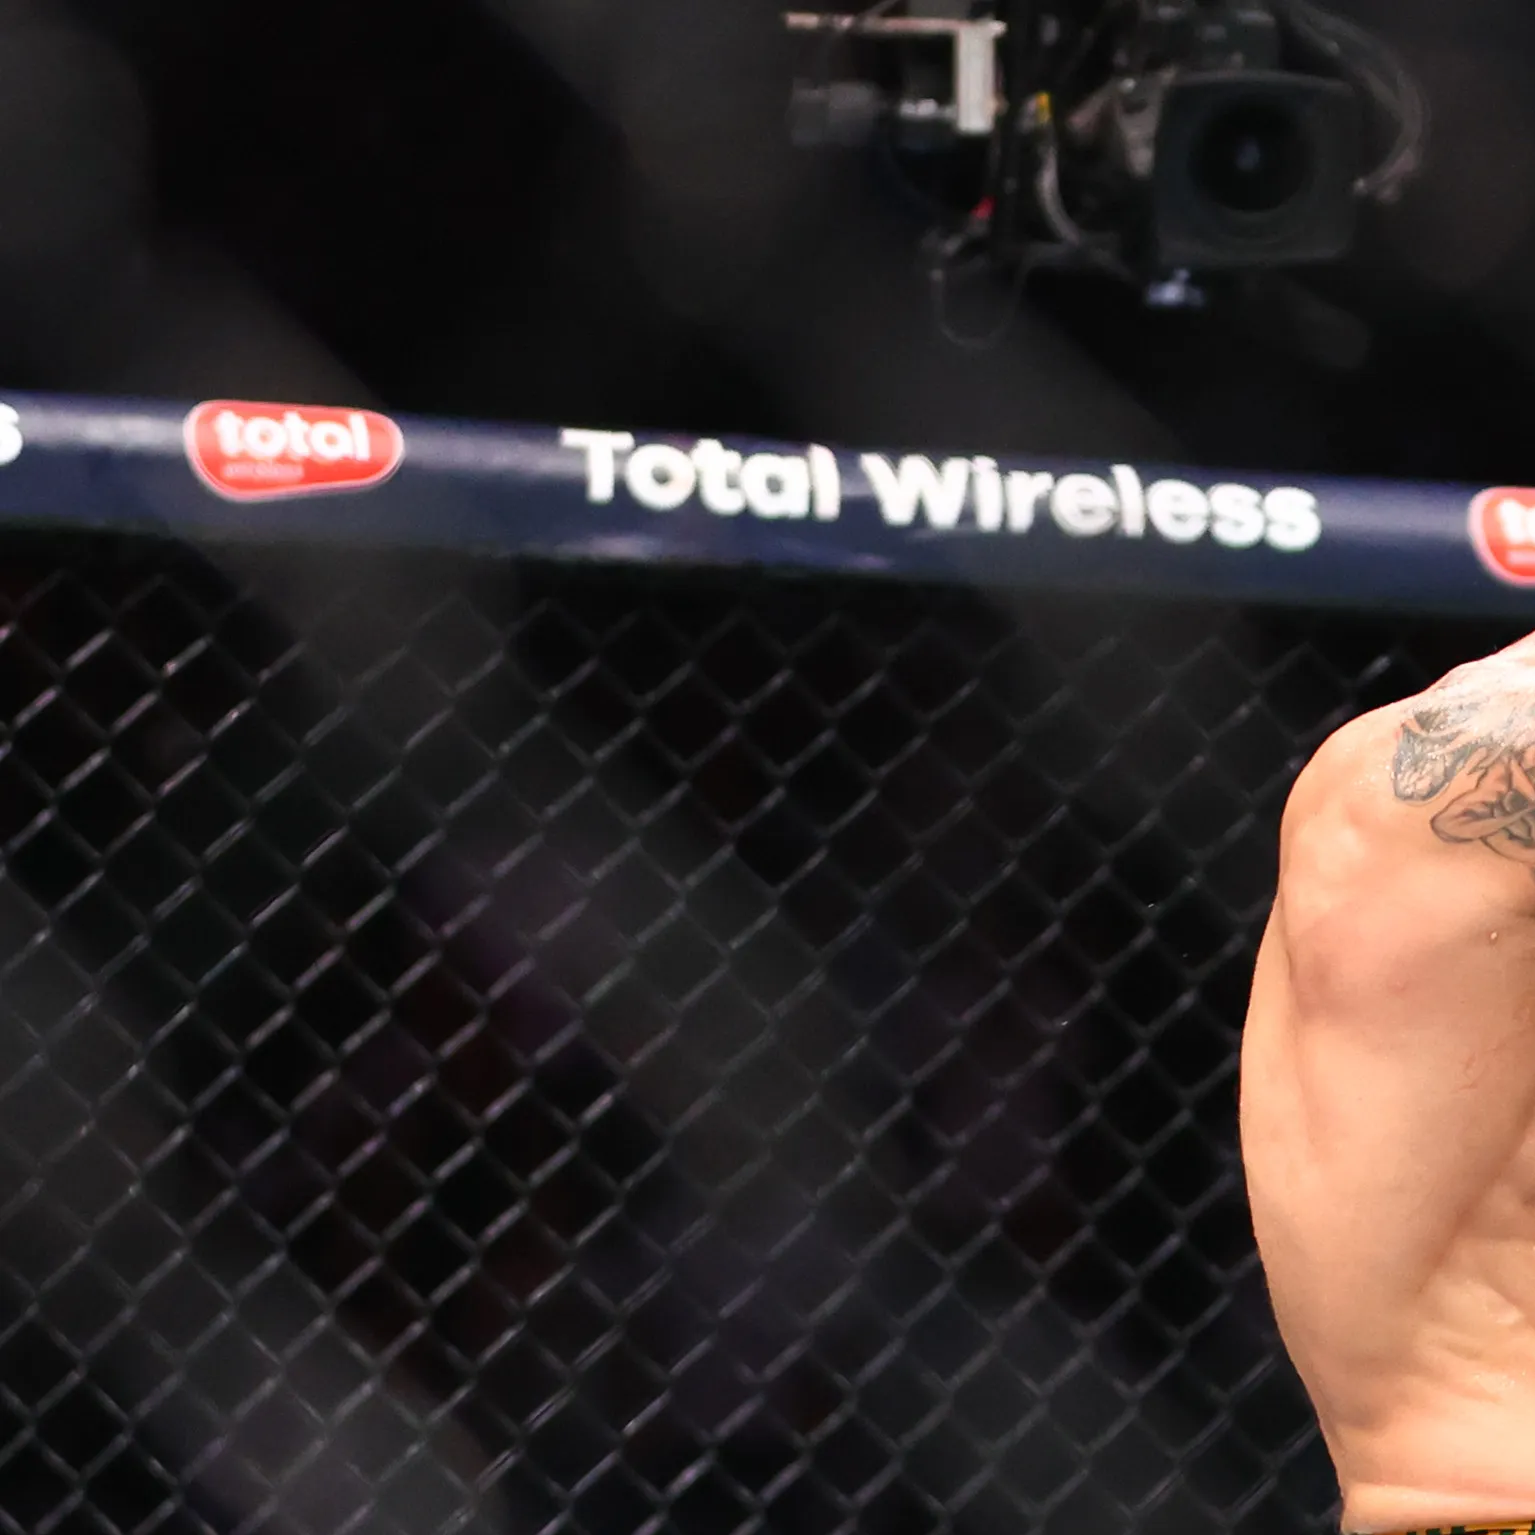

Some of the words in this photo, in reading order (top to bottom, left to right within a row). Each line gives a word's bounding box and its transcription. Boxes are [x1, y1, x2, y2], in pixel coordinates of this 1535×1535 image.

[214, 410, 371, 462] total
[560, 427, 841, 521] Total
[861, 450, 1322, 552] Wireless
